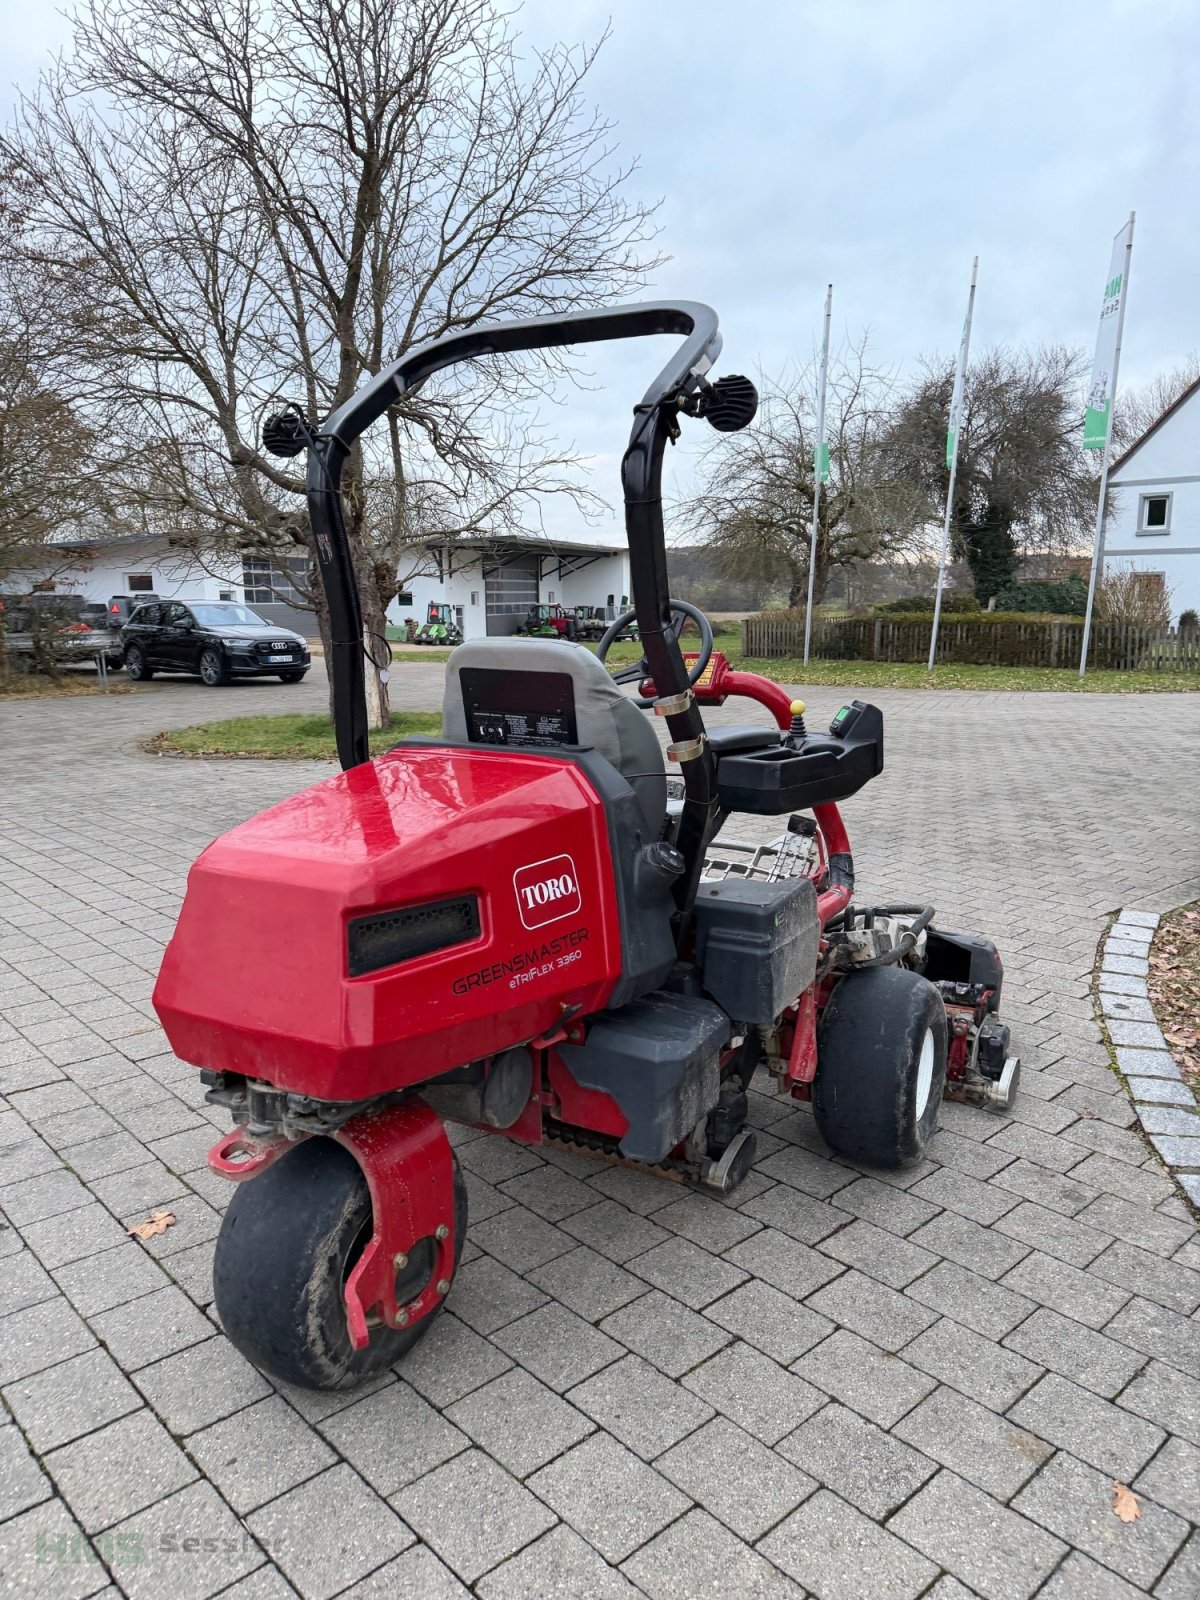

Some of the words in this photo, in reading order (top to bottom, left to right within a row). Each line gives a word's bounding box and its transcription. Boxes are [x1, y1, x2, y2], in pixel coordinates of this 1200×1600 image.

[521, 874, 575, 909] TORO
[452, 927, 589, 995] GREENSMASTER
[557, 949, 582, 967] 3360
